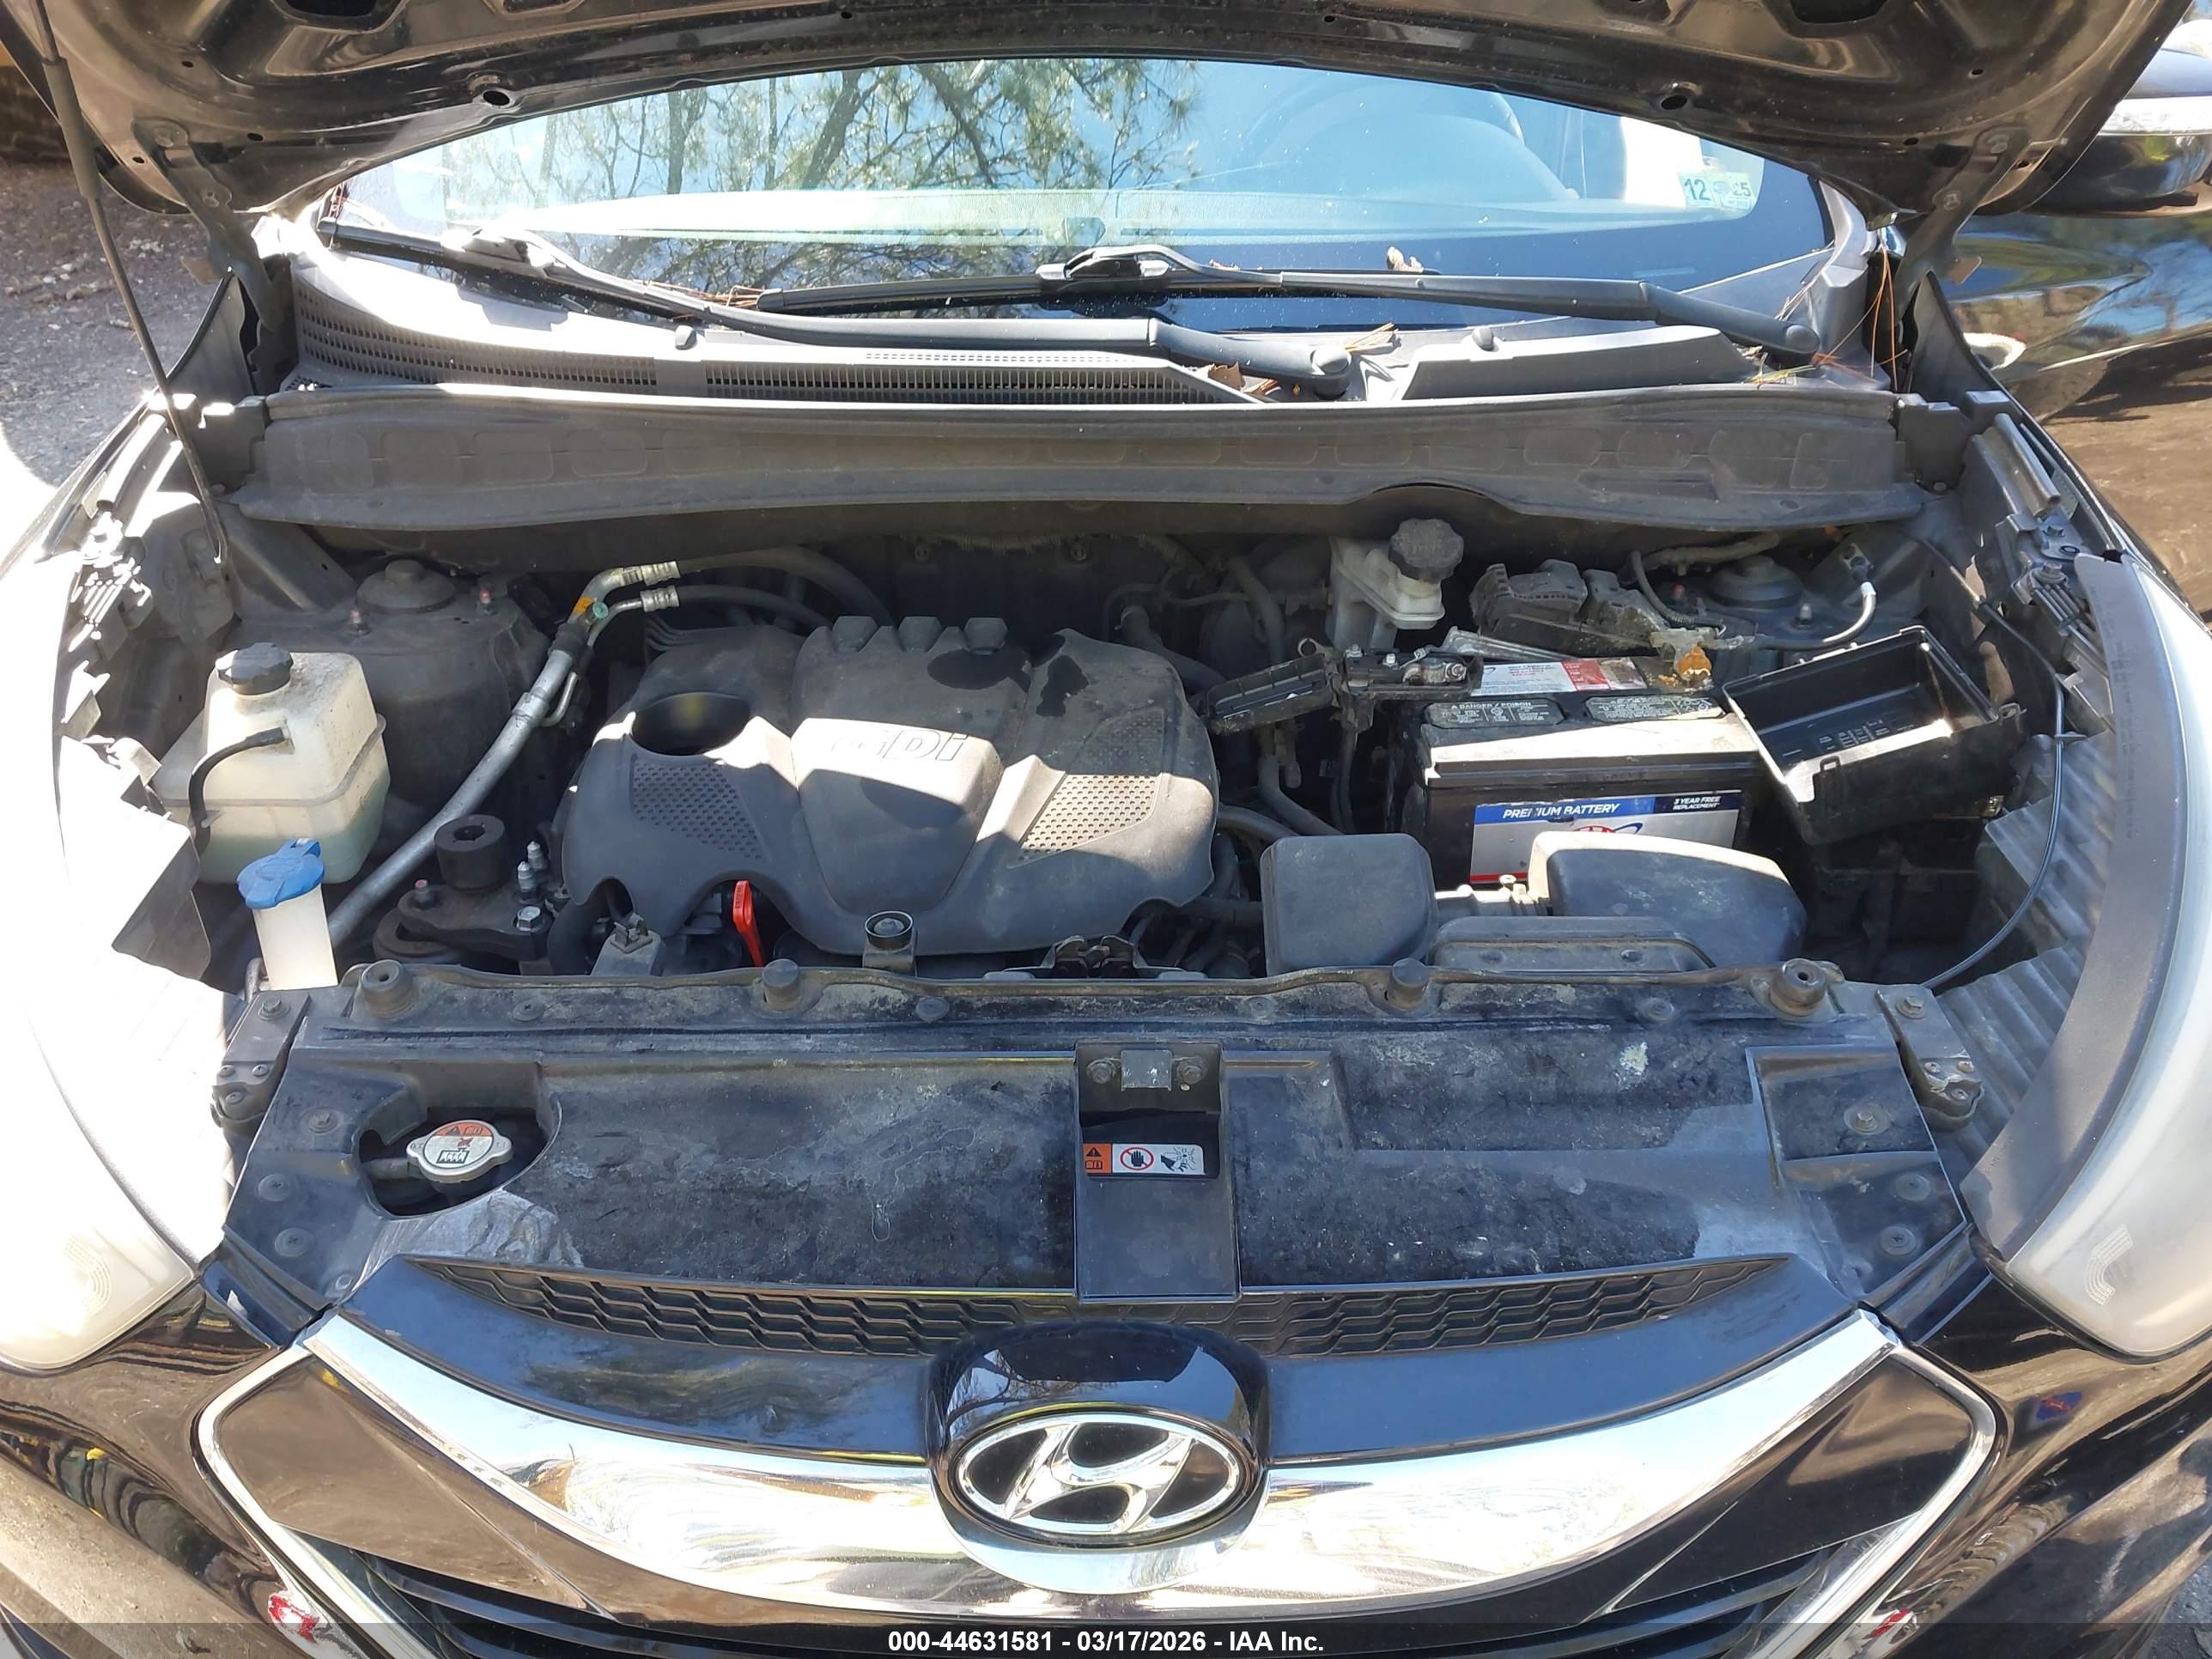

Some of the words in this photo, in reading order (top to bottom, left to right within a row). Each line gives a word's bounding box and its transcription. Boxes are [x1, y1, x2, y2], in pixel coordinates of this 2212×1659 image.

[1684, 179, 1711, 201] 12
[1564, 803, 1621, 815] BATTERY
[1673, 802, 1721, 811] REPLACEMENT
